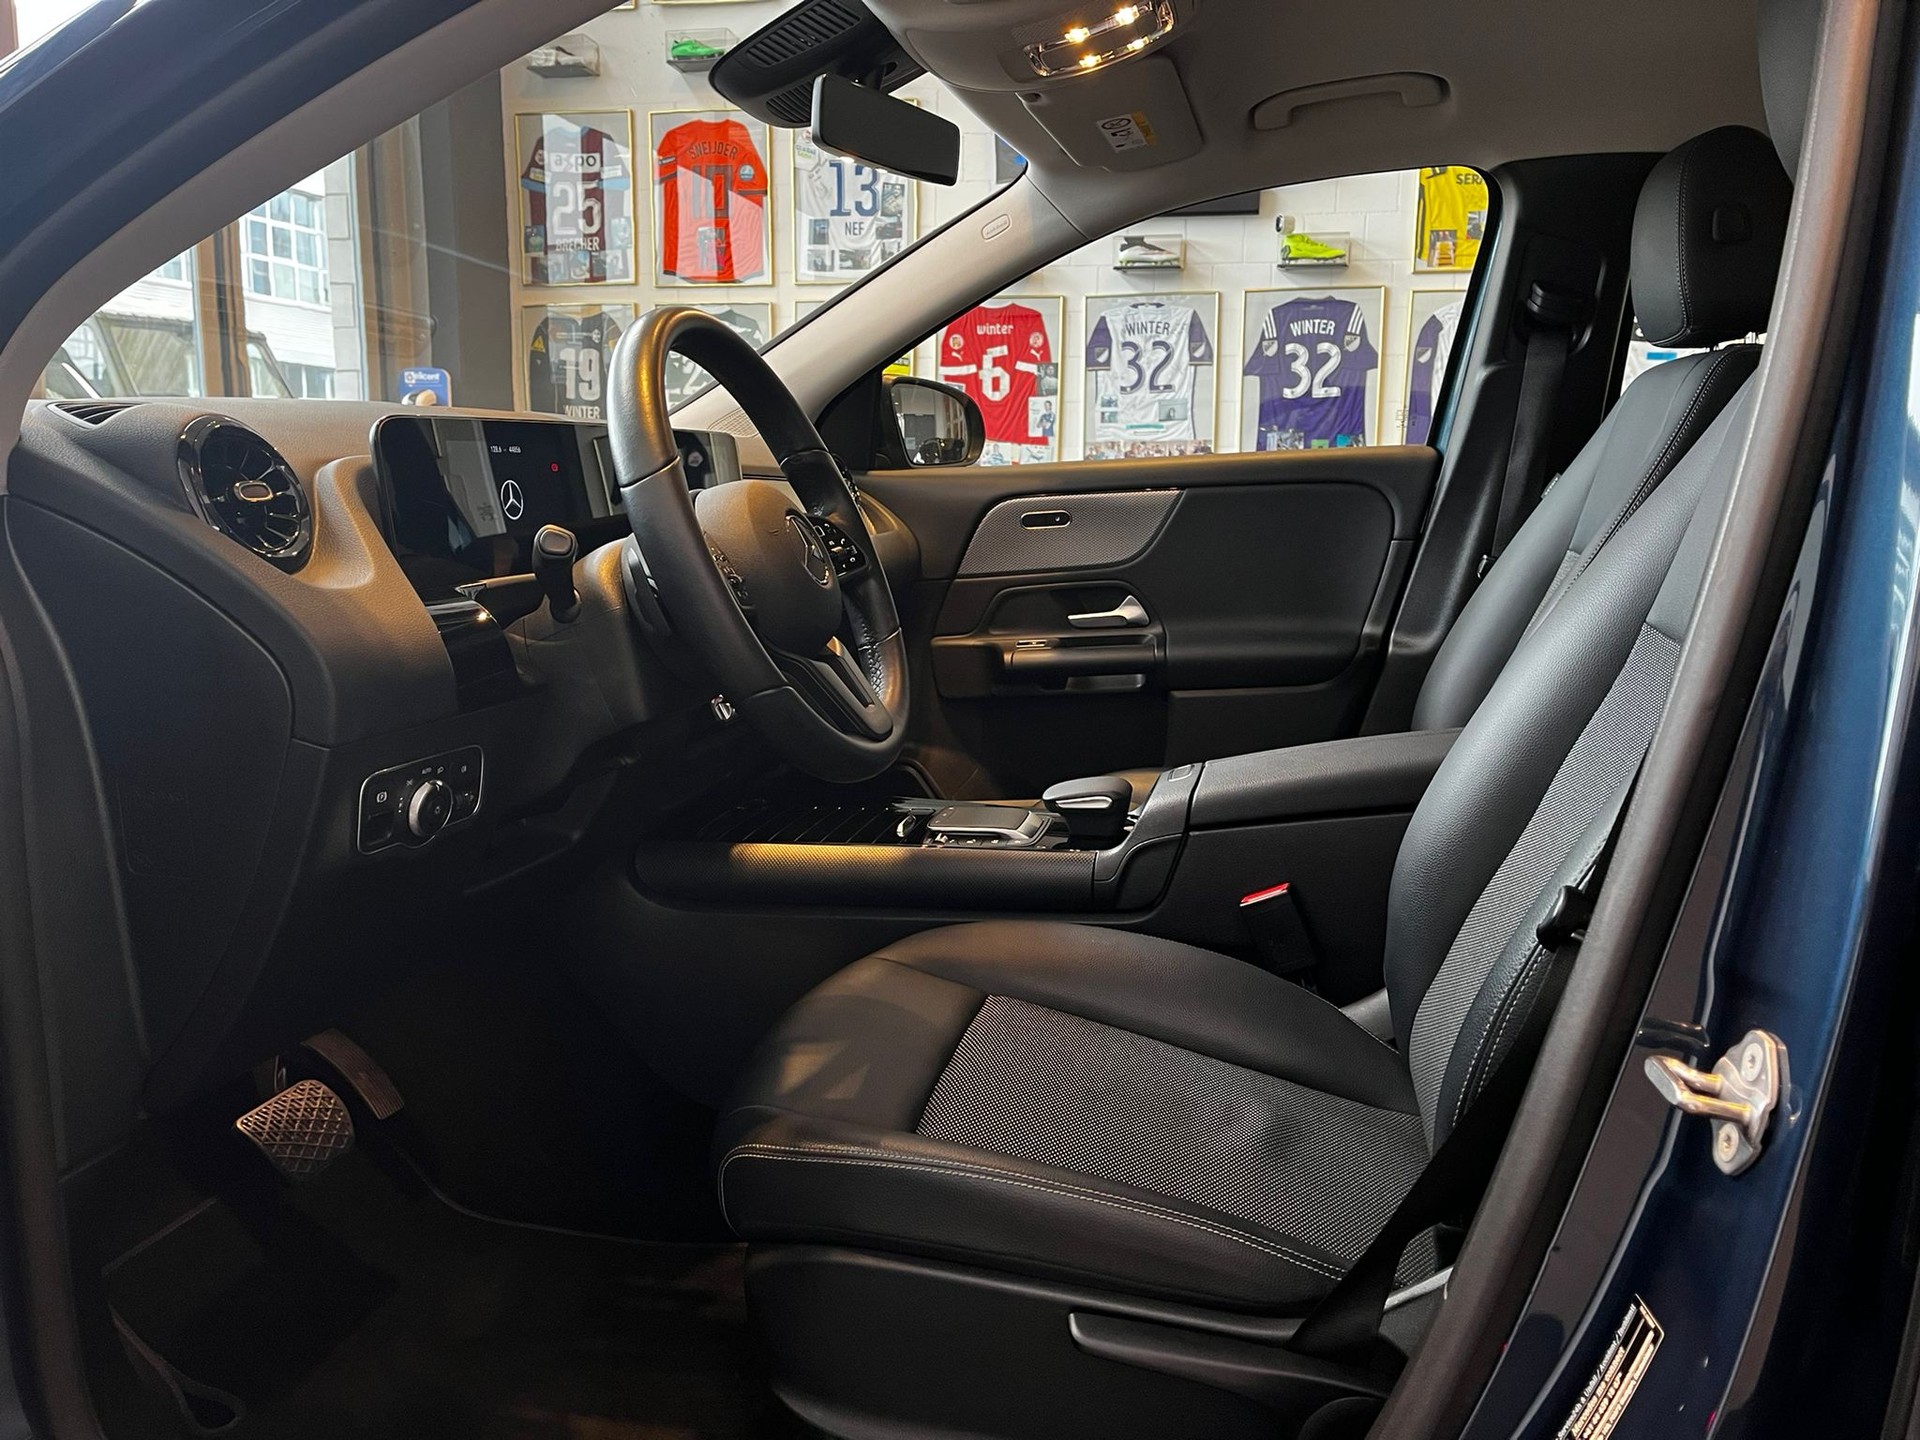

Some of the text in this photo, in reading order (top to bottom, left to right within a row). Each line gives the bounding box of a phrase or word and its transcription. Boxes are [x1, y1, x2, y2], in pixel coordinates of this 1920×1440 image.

[552, 180, 601, 235] 25
[692, 164, 733, 219] 10
[829, 160, 880, 217] 13
[555, 236, 600, 253] BRECHER
[845, 221, 865, 236] NEF
[977, 323, 1014, 335] winter
[1125, 320, 1171, 337] WINTER
[1289, 318, 1336, 337] WINTER
[559, 346, 600, 401] 19
[977, 344, 1011, 402] 6
[1119, 339, 1175, 395] 32
[1282, 342, 1342, 399] 32
[564, 404, 600, 419] WINTER
[1571, 1395, 1598, 1437] Mercedes
[1604, 1346, 1625, 1381] connect
